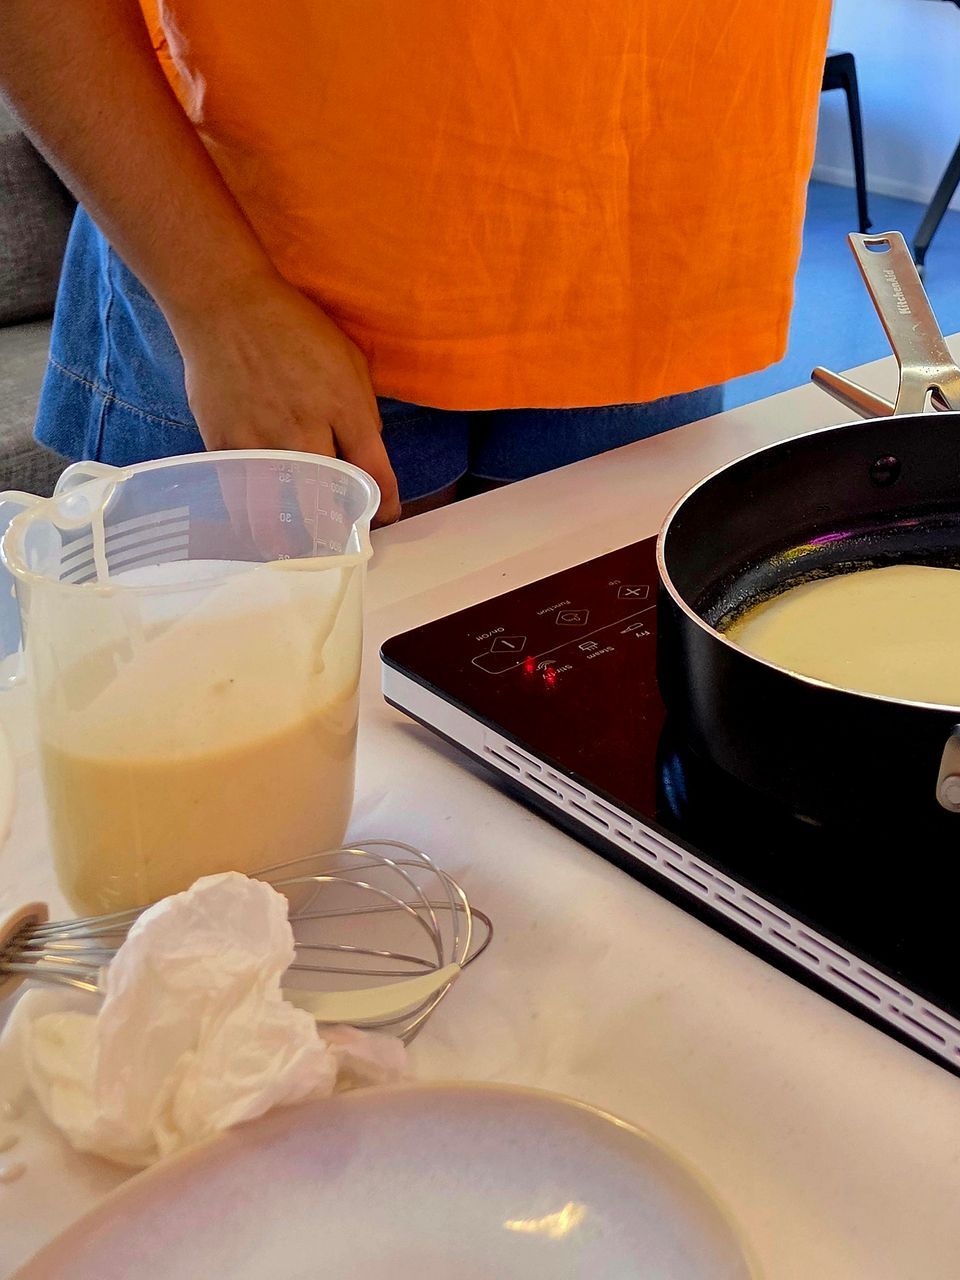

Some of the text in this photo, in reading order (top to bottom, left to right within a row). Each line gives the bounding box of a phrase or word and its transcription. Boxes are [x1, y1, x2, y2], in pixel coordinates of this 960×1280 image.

[883, 269, 911, 315] KitchenAid
[536, 599, 572, 616] Function
[475, 626, 505, 642] On/Off
[635, 629, 650, 639] Fry
[586, 645, 616, 660] Steam
